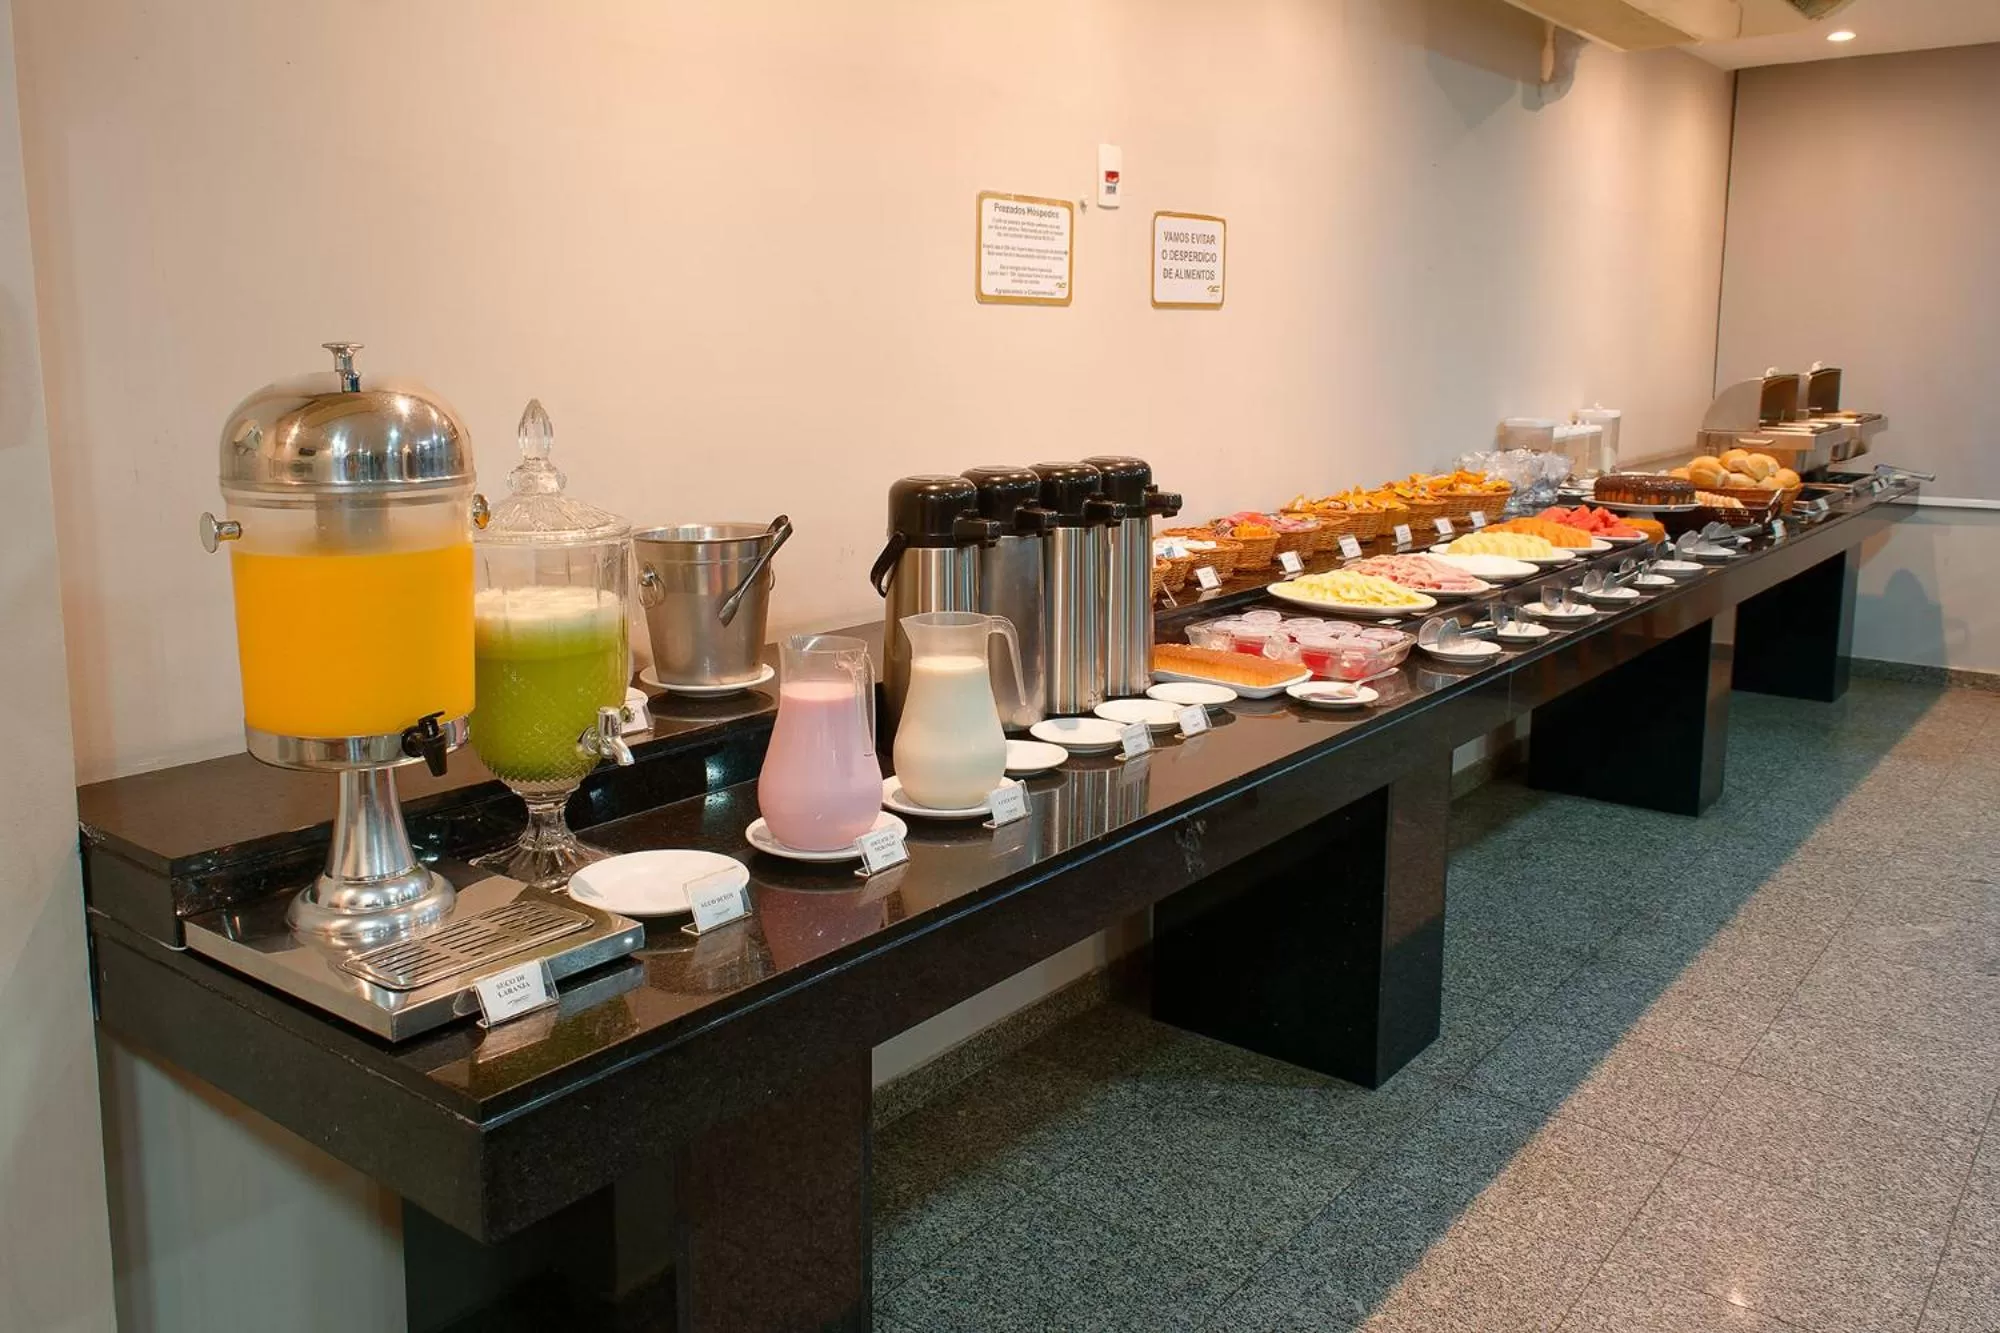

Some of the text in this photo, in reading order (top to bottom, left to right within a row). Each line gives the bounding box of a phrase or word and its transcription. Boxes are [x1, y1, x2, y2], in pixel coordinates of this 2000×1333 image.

[1163, 231, 1217, 245] VAMOS EVITAR
[1161, 249, 1168, 261] O
[1162, 267, 1216, 281] DE ALIMENTOS
[496, 981, 532, 999] LARANJA
